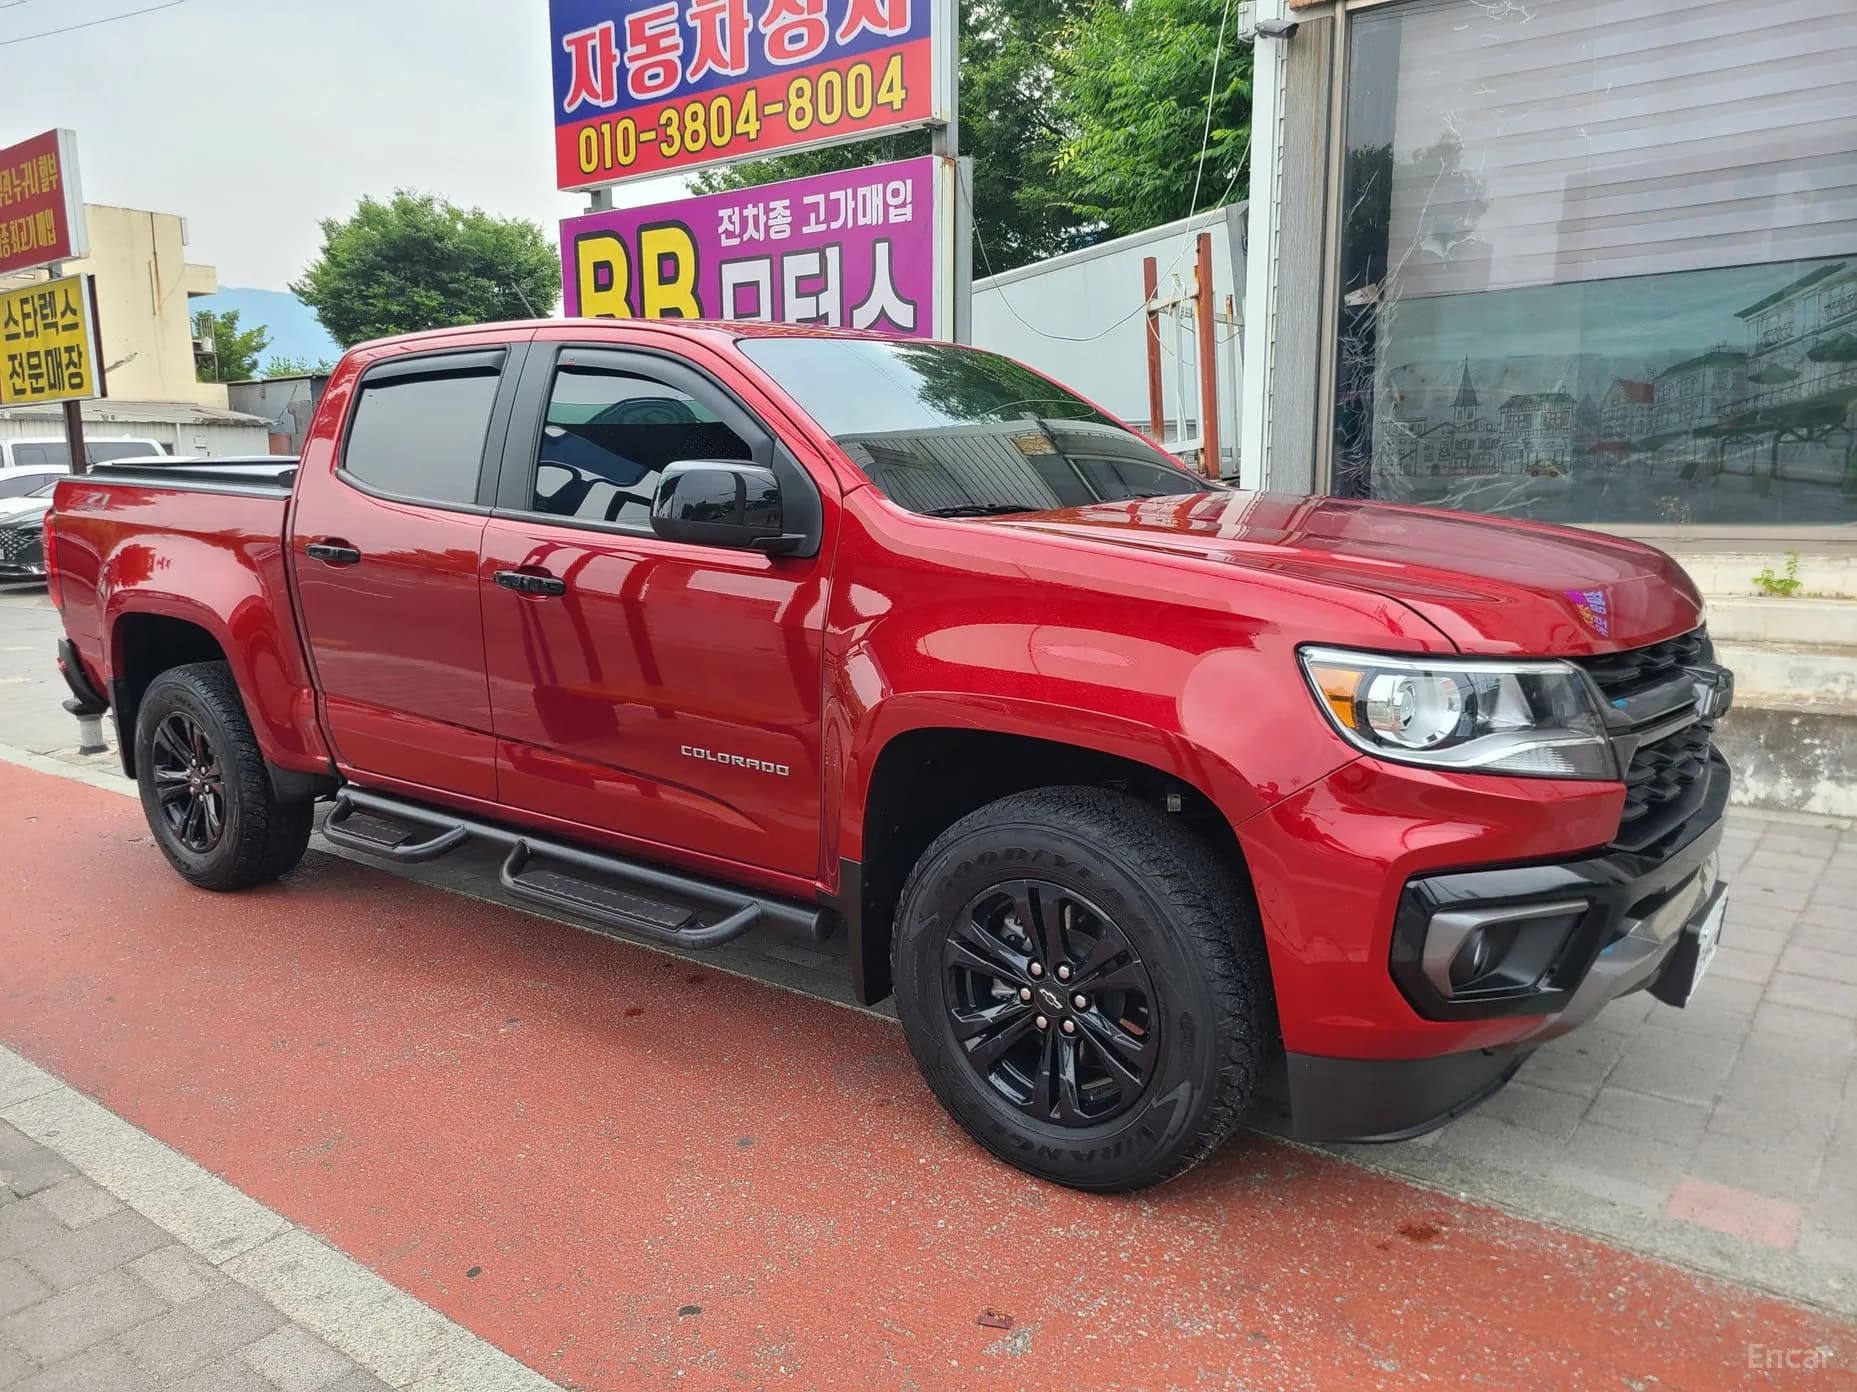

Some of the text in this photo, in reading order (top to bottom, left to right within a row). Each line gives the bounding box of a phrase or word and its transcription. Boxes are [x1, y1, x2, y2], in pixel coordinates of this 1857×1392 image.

[578, 53, 907, 174] 010-3804-8004
[717, 179, 914, 248] 전차종 고가매입
[3, 288, 81, 342] 스타렉스
[7, 343, 85, 396] 전문매장
[680, 745, 790, 777] COLORADO
